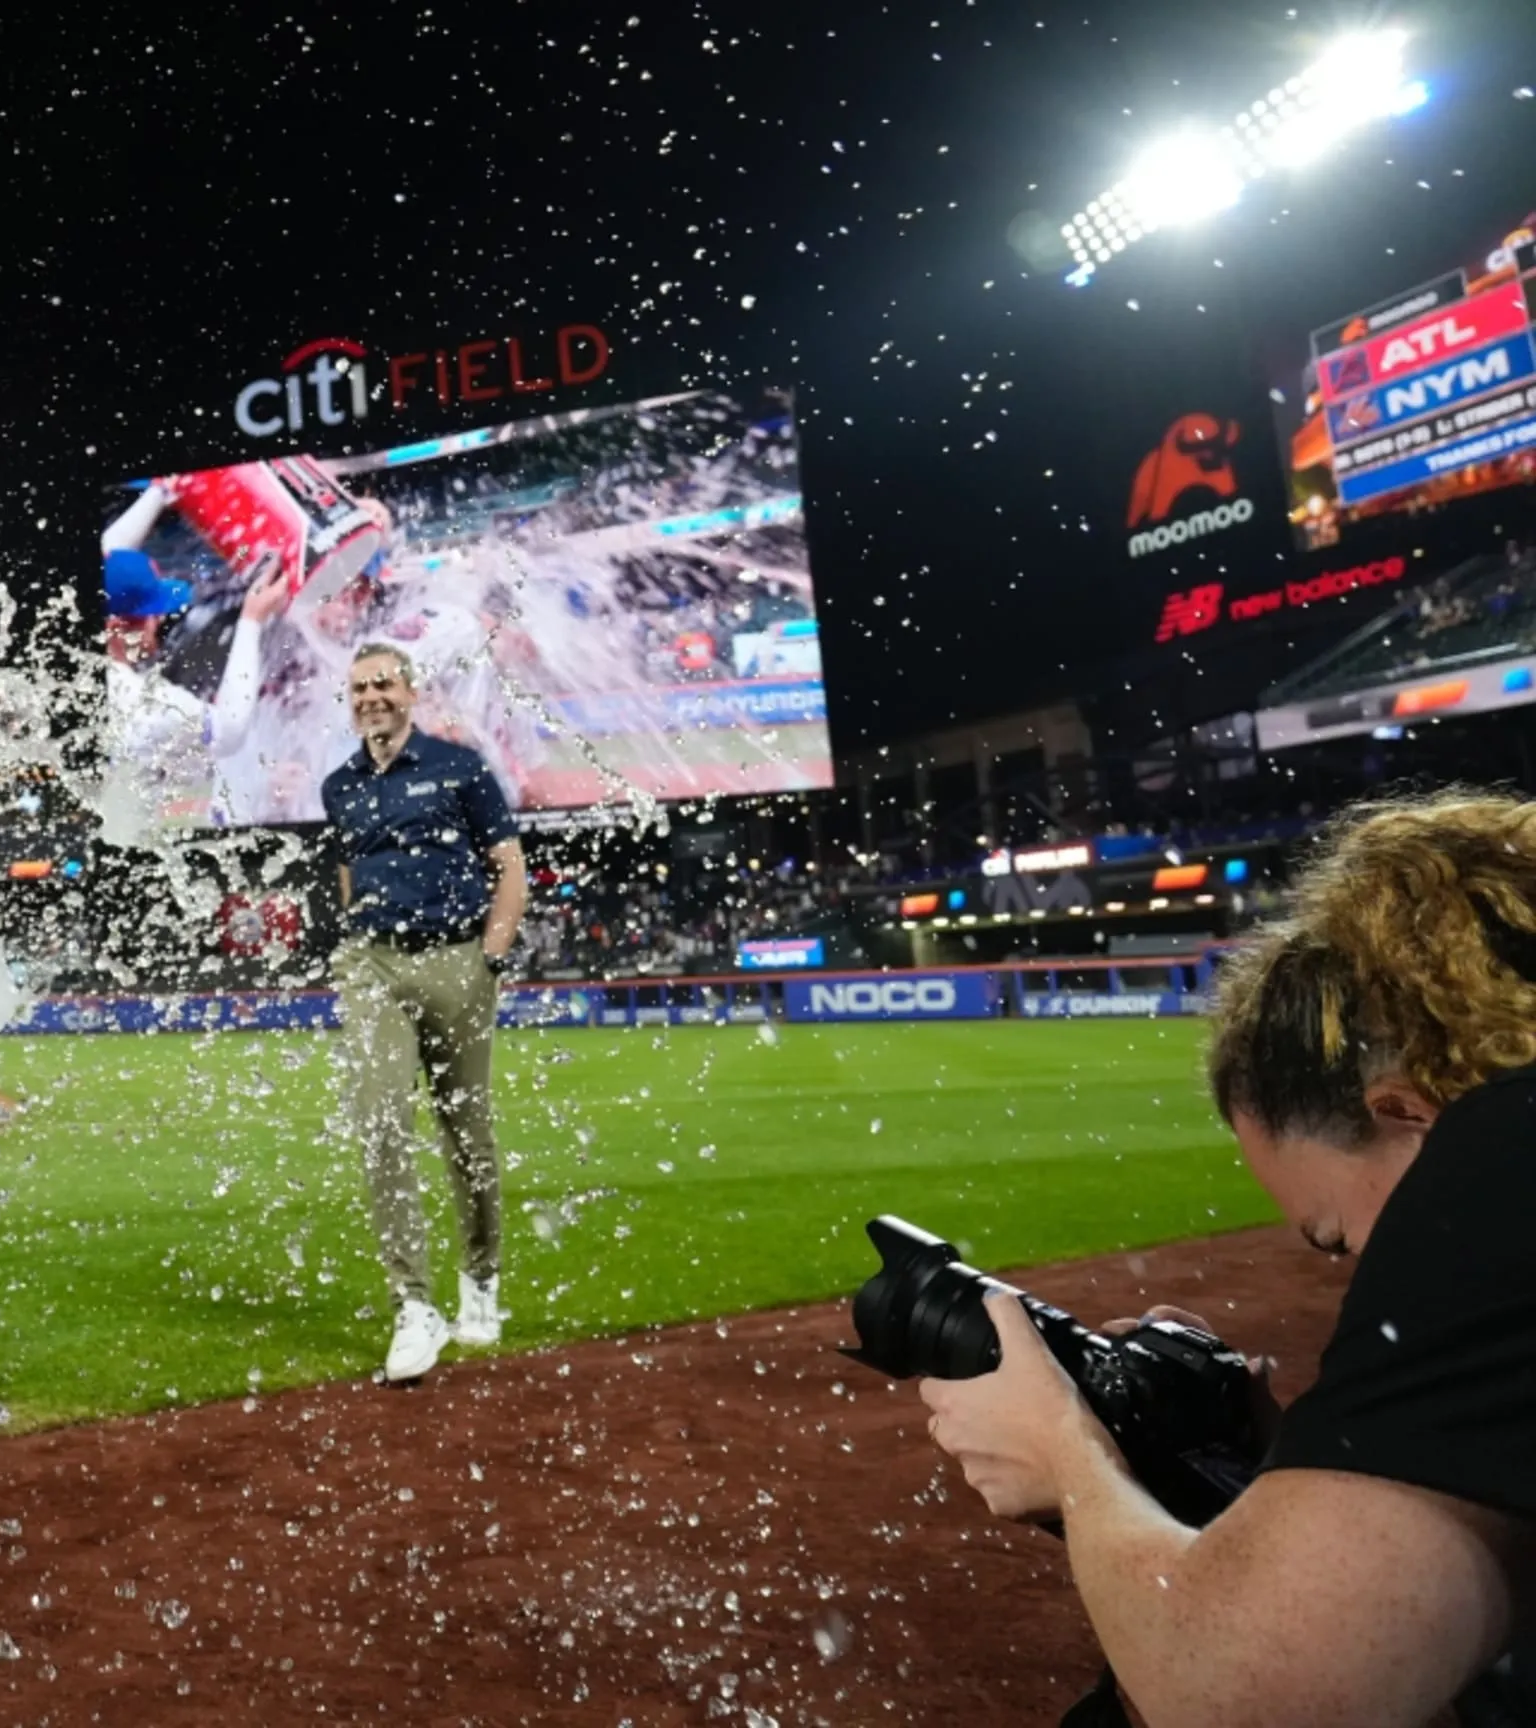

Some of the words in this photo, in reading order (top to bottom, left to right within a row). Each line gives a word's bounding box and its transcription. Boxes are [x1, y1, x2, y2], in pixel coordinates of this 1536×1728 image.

[1379, 317, 1476, 371] ATL
[234, 352, 368, 437] citi
[388, 324, 610, 412] FIELD
[1385, 348, 1510, 417] NYM
[1128, 498, 1254, 558] moomoo
[1230, 591, 1283, 621] new
[1286, 556, 1405, 606] balance
[809, 979, 957, 1013] NOCO
